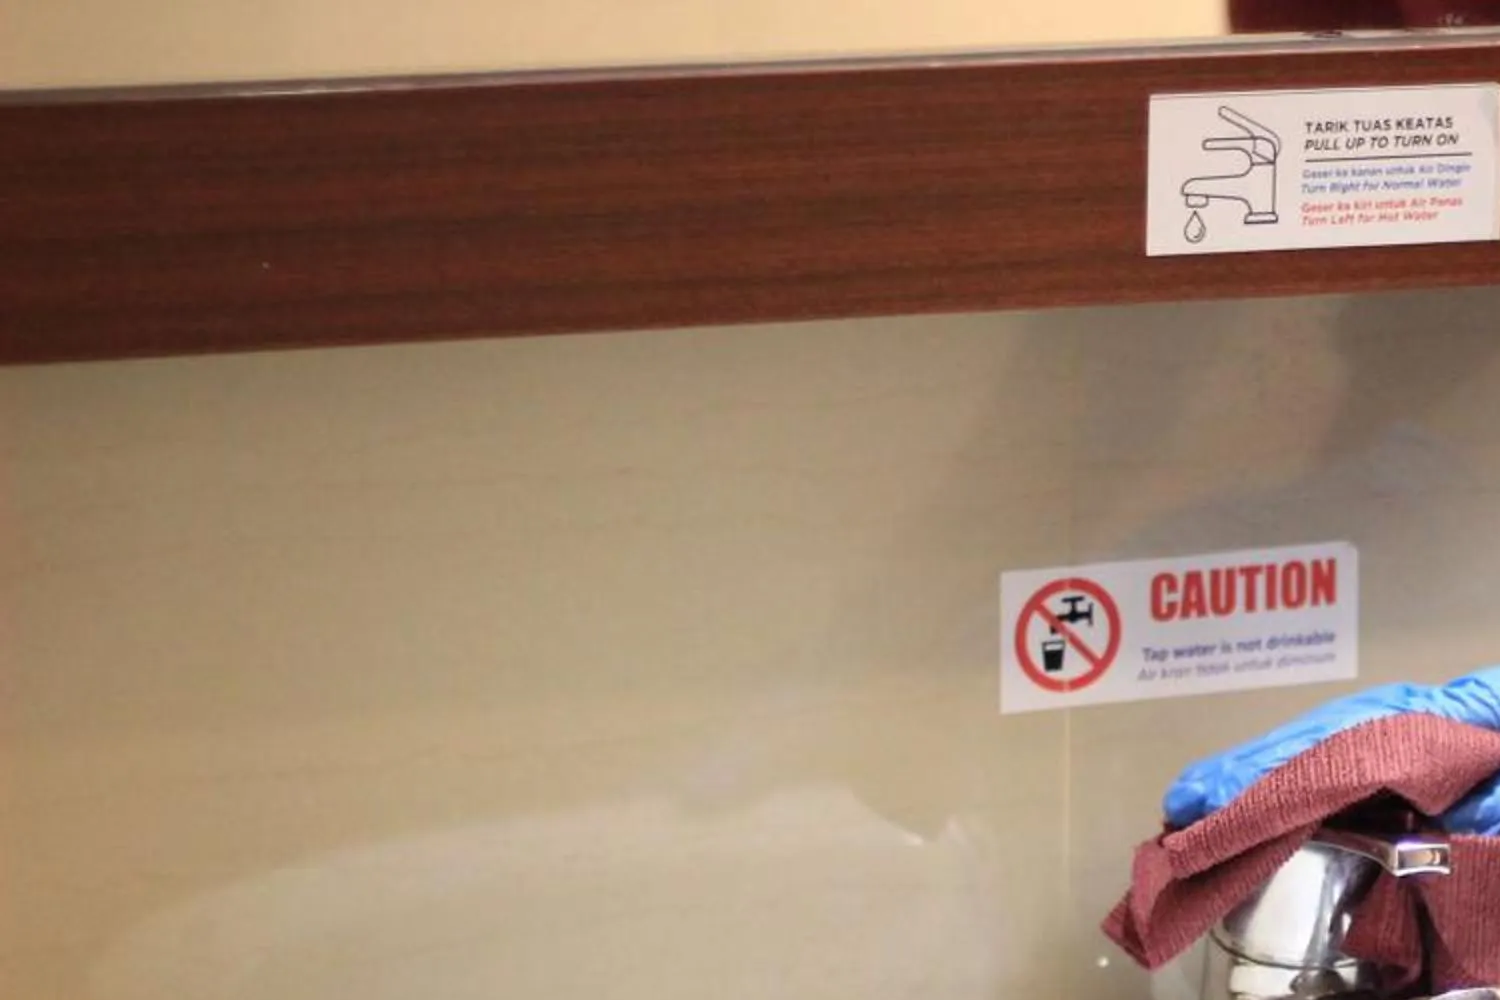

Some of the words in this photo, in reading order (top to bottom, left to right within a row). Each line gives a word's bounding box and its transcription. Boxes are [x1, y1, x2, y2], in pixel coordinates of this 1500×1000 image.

[1304, 121, 1348, 134] TARIK
[1354, 119, 1391, 132] TUAS
[1395, 116, 1453, 130] KEATAS
[1304, 138, 1341, 151] PULL
[1345, 137, 1365, 149] UP
[1370, 135, 1389, 148] TO
[1394, 134, 1432, 147] TURN
[1436, 133, 1459, 145] ON
[1302, 169, 1333, 179] Geser
[1351, 166, 1383, 177] kanan
[1385, 165, 1415, 174] untuk
[1419, 164, 1433, 173] Air
[1437, 162, 1471, 174] Dingin
[1302, 183, 1326, 194] Turn
[1329, 182, 1359, 194] Right
[1363, 180, 1379, 191] for
[1382, 179, 1423, 190] Normal
[1427, 177, 1461, 188] Water
[1302, 202, 1335, 213] Geser
[1354, 199, 1372, 210] kiri
[1375, 198, 1406, 209] untuk
[1411, 197, 1427, 206] Air
[1430, 196, 1463, 206] Panas
[1302, 215, 1327, 226] Turn
[1331, 214, 1355, 225] Left
[1358, 213, 1374, 223] for
[1379, 212, 1399, 222] Hot
[1403, 211, 1439, 221] Water
[1149, 557, 1338, 622] CAUTION
[1142, 646, 1170, 662] Tap
[1173, 643, 1217, 659] water
[1220, 639, 1232, 654] is
[1237, 639, 1262, 653] not
[1266, 628, 1336, 650] drinkable
